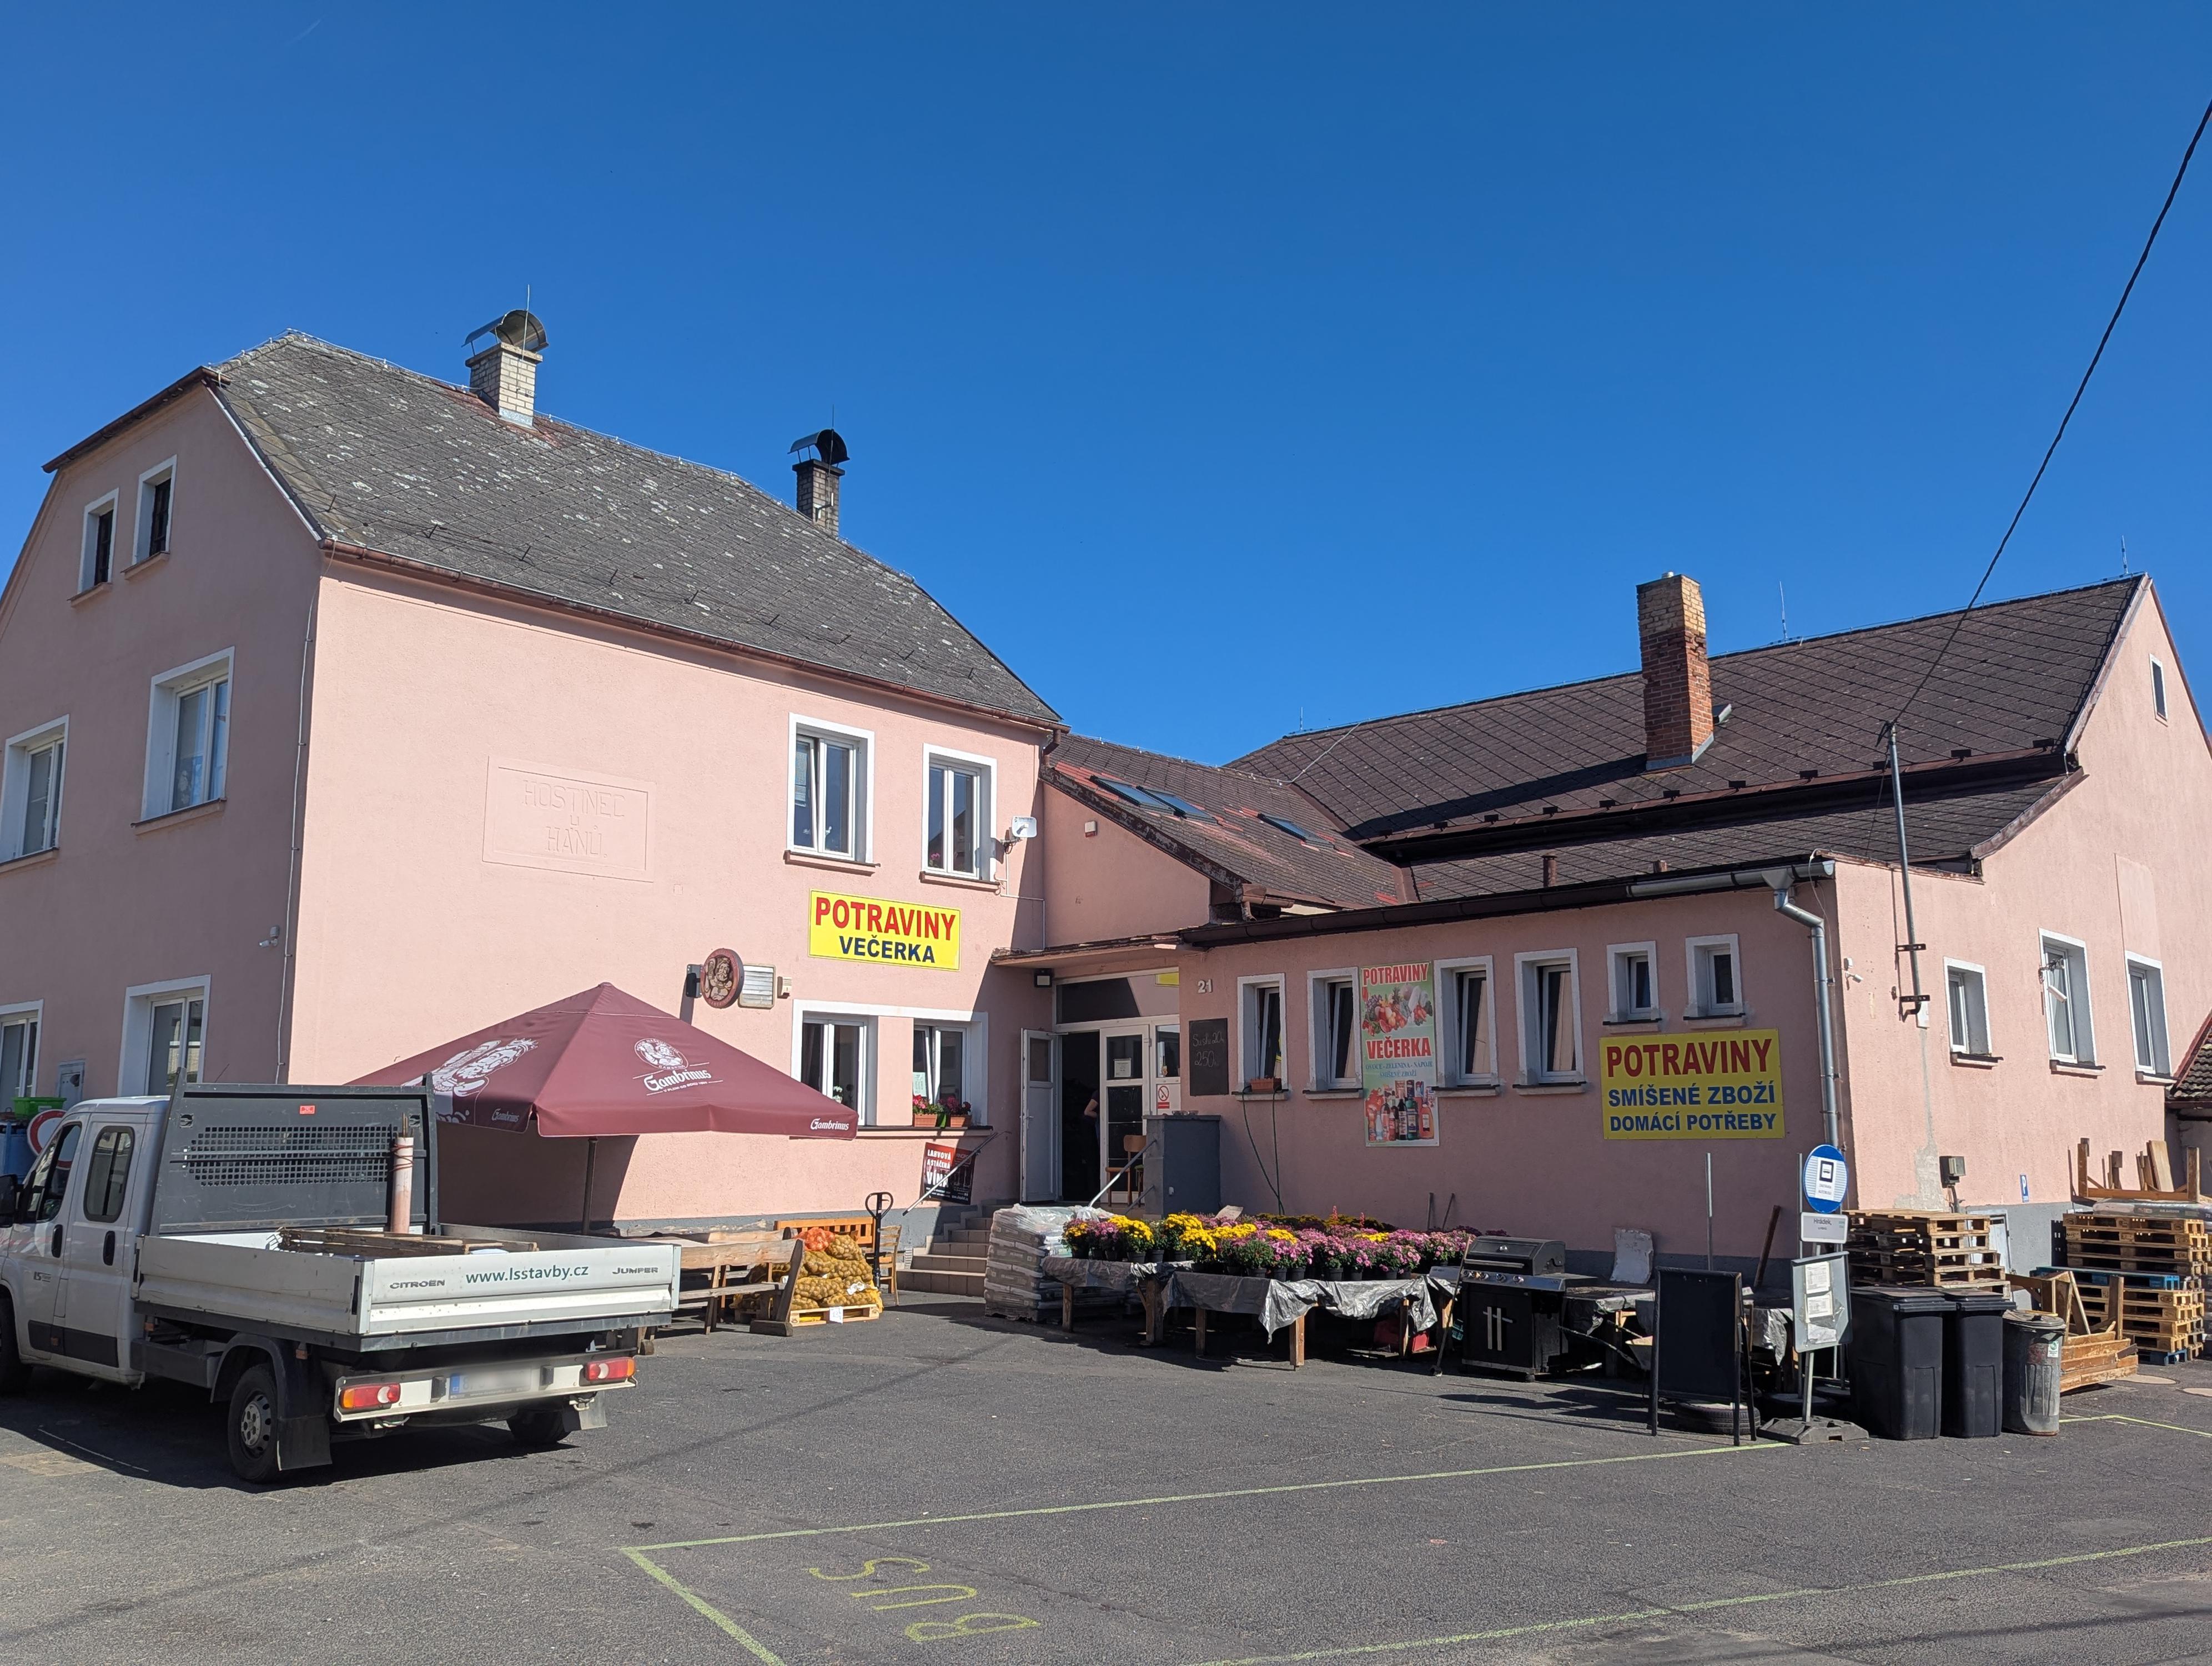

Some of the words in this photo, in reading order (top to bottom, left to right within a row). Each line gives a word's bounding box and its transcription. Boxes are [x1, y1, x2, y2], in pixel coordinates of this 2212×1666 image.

[522, 780, 626, 818] HOSTINEC
[816, 897, 956, 941] POTRAVINY
[839, 934, 935, 964] VEČERKA
[1198, 979, 1213, 993] 21
[1363, 963, 1429, 986] POTRAVINY
[1366, 1036, 1432, 1060] VEČERKA
[1607, 1038, 1772, 1077] POTRAVINY
[644, 1070, 712, 1091] Gambrinus
[1608, 1083, 1701, 1107] SMÍŠENÉ
[1708, 1080, 1775, 1105] ZBOŽÍ
[810, 1118, 849, 1131] Gambrinus
[1610, 1111, 1680, 1131] DOMÁCÍ
[1687, 1110, 1776, 1130] POTŘEBY
[927, 1149, 951, 1161] LAHVOVÁ
[390, 1279, 445, 1289] CITROËN
[466, 1264, 589, 1283] www.lsstavby.cz
[808, 1557, 1041, 1642] BUS
